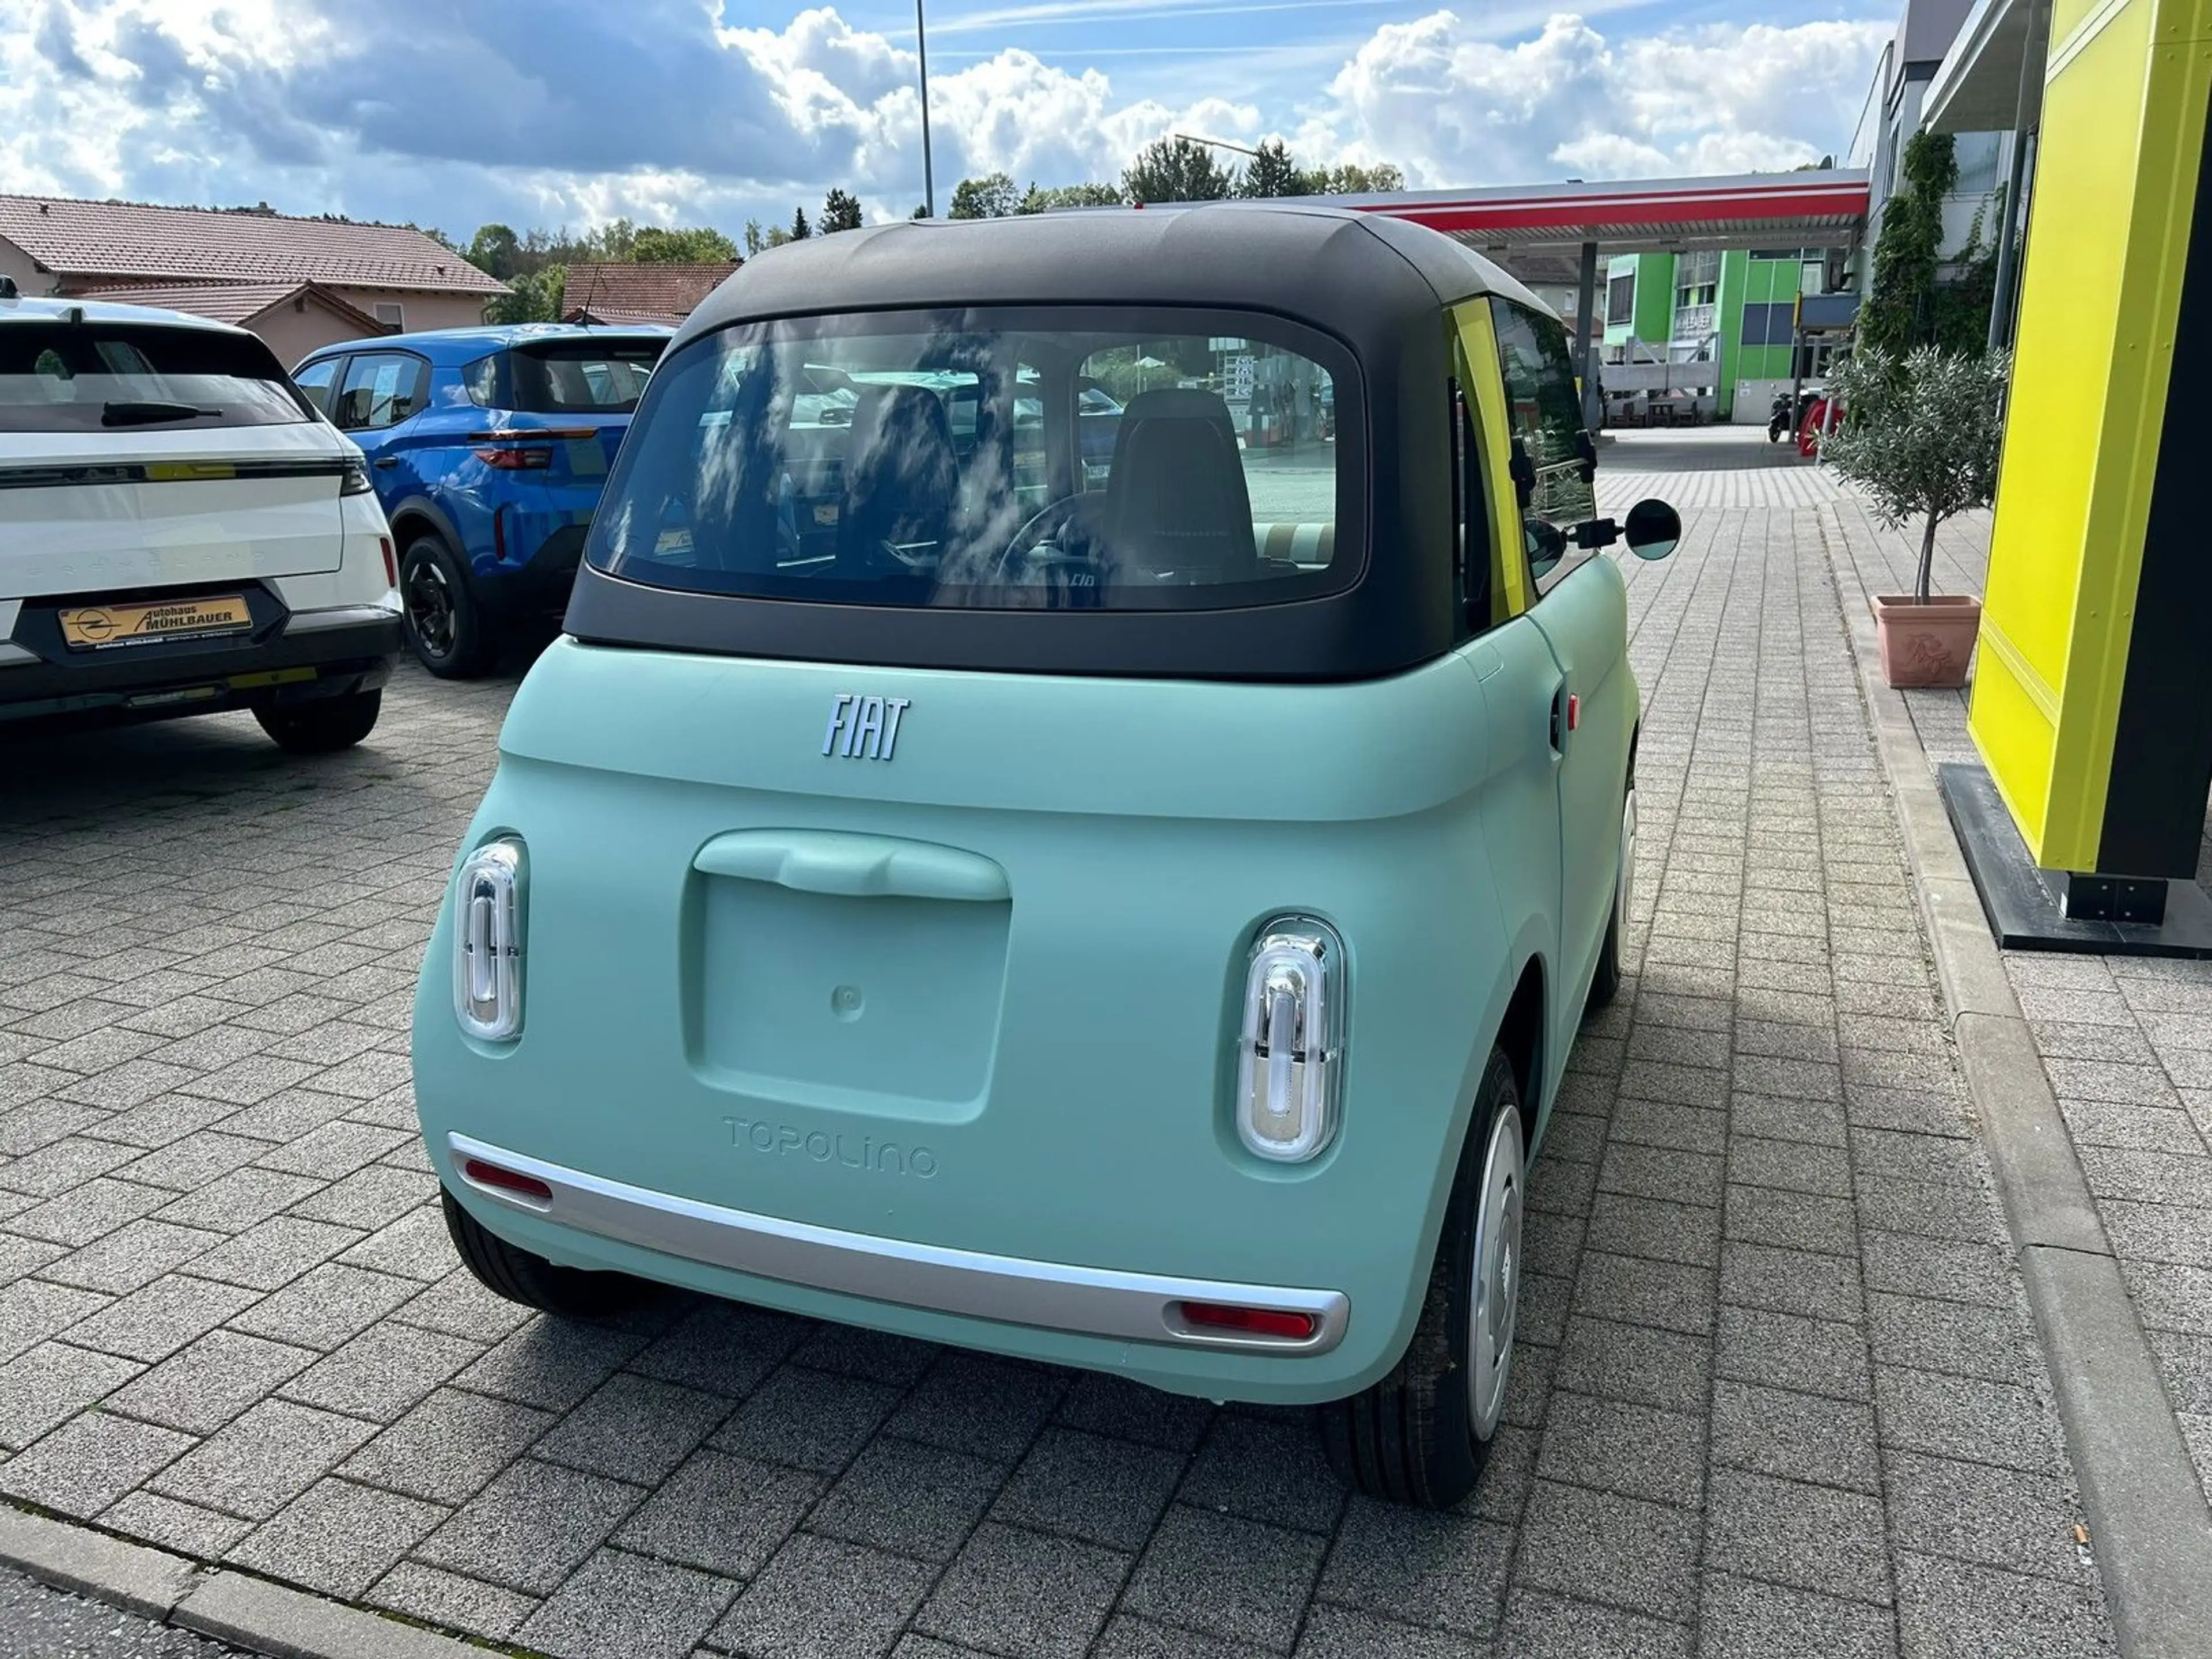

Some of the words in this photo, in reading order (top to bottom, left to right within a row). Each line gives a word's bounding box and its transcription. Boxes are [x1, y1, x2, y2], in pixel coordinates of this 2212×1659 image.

[134, 605, 198, 632] Autohaus
[145, 611, 233, 630] MÜHLBAUER
[822, 694, 911, 760] FIAT
